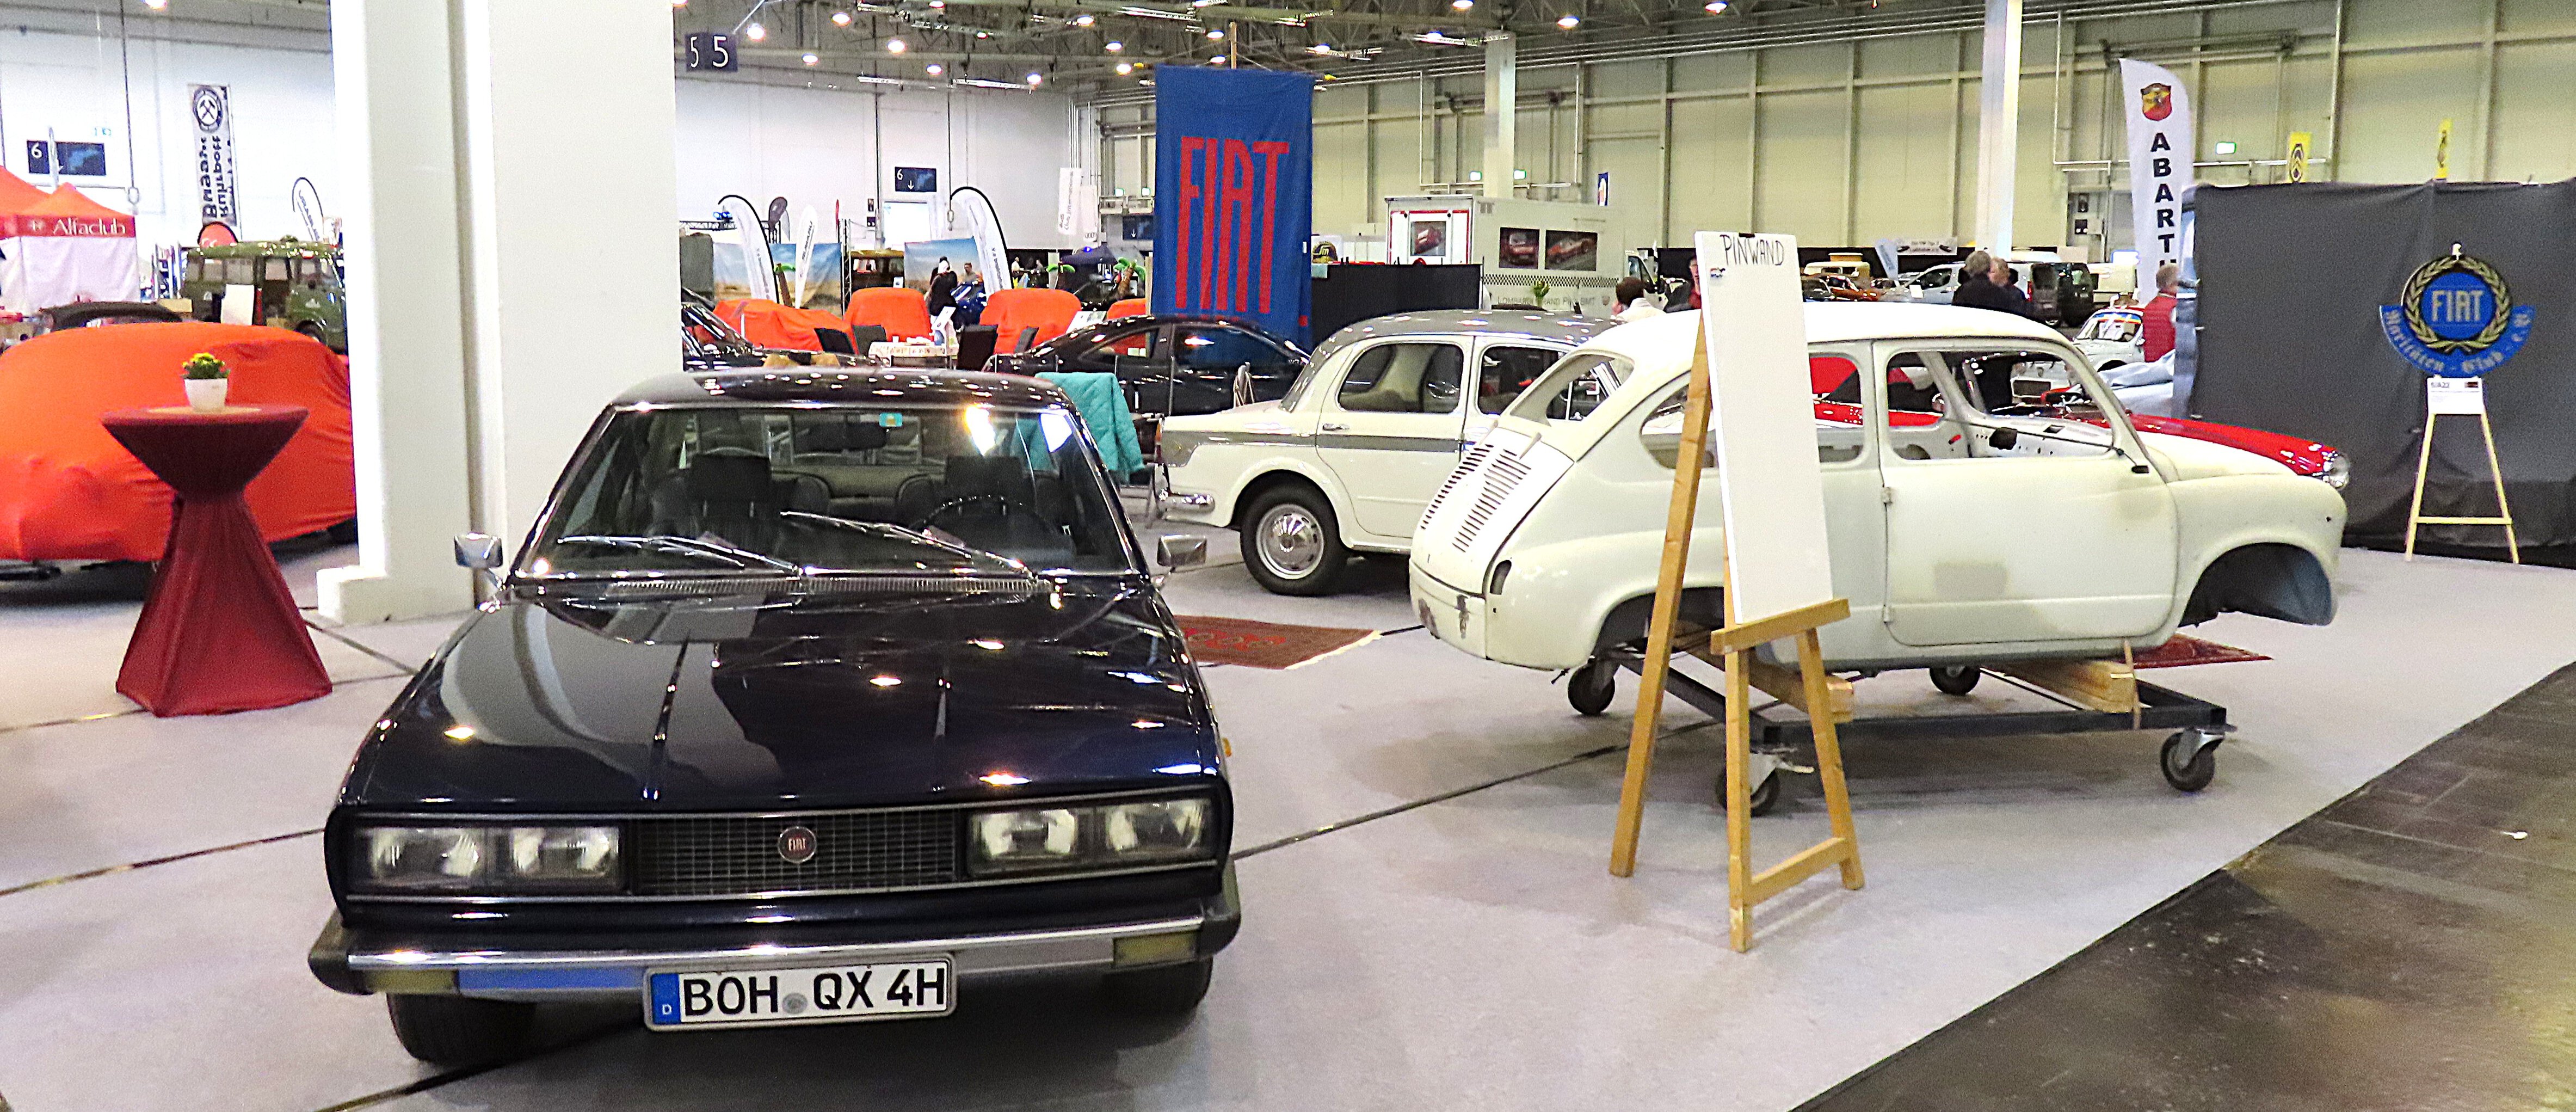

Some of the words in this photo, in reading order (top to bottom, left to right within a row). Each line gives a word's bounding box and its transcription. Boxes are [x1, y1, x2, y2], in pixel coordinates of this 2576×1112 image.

[690, 36, 699, 68] 5
[712, 35, 729, 67] 5
[31, 142, 44, 159] 6
[896, 169, 903, 180] 6
[2150, 132, 2177, 268] ABART
[53, 217, 126, 236] Alfaclub
[1175, 136, 1290, 314] FIAT
[1720, 234, 1784, 266] PINWAND
[2432, 290, 2484, 322] FIAT
[788, 838, 806, 851] FIAT
[683, 975, 779, 1016] BOH
[813, 970, 874, 1011] QX
[886, 967, 946, 1006] 4H
[662, 1004, 672, 1016] D
